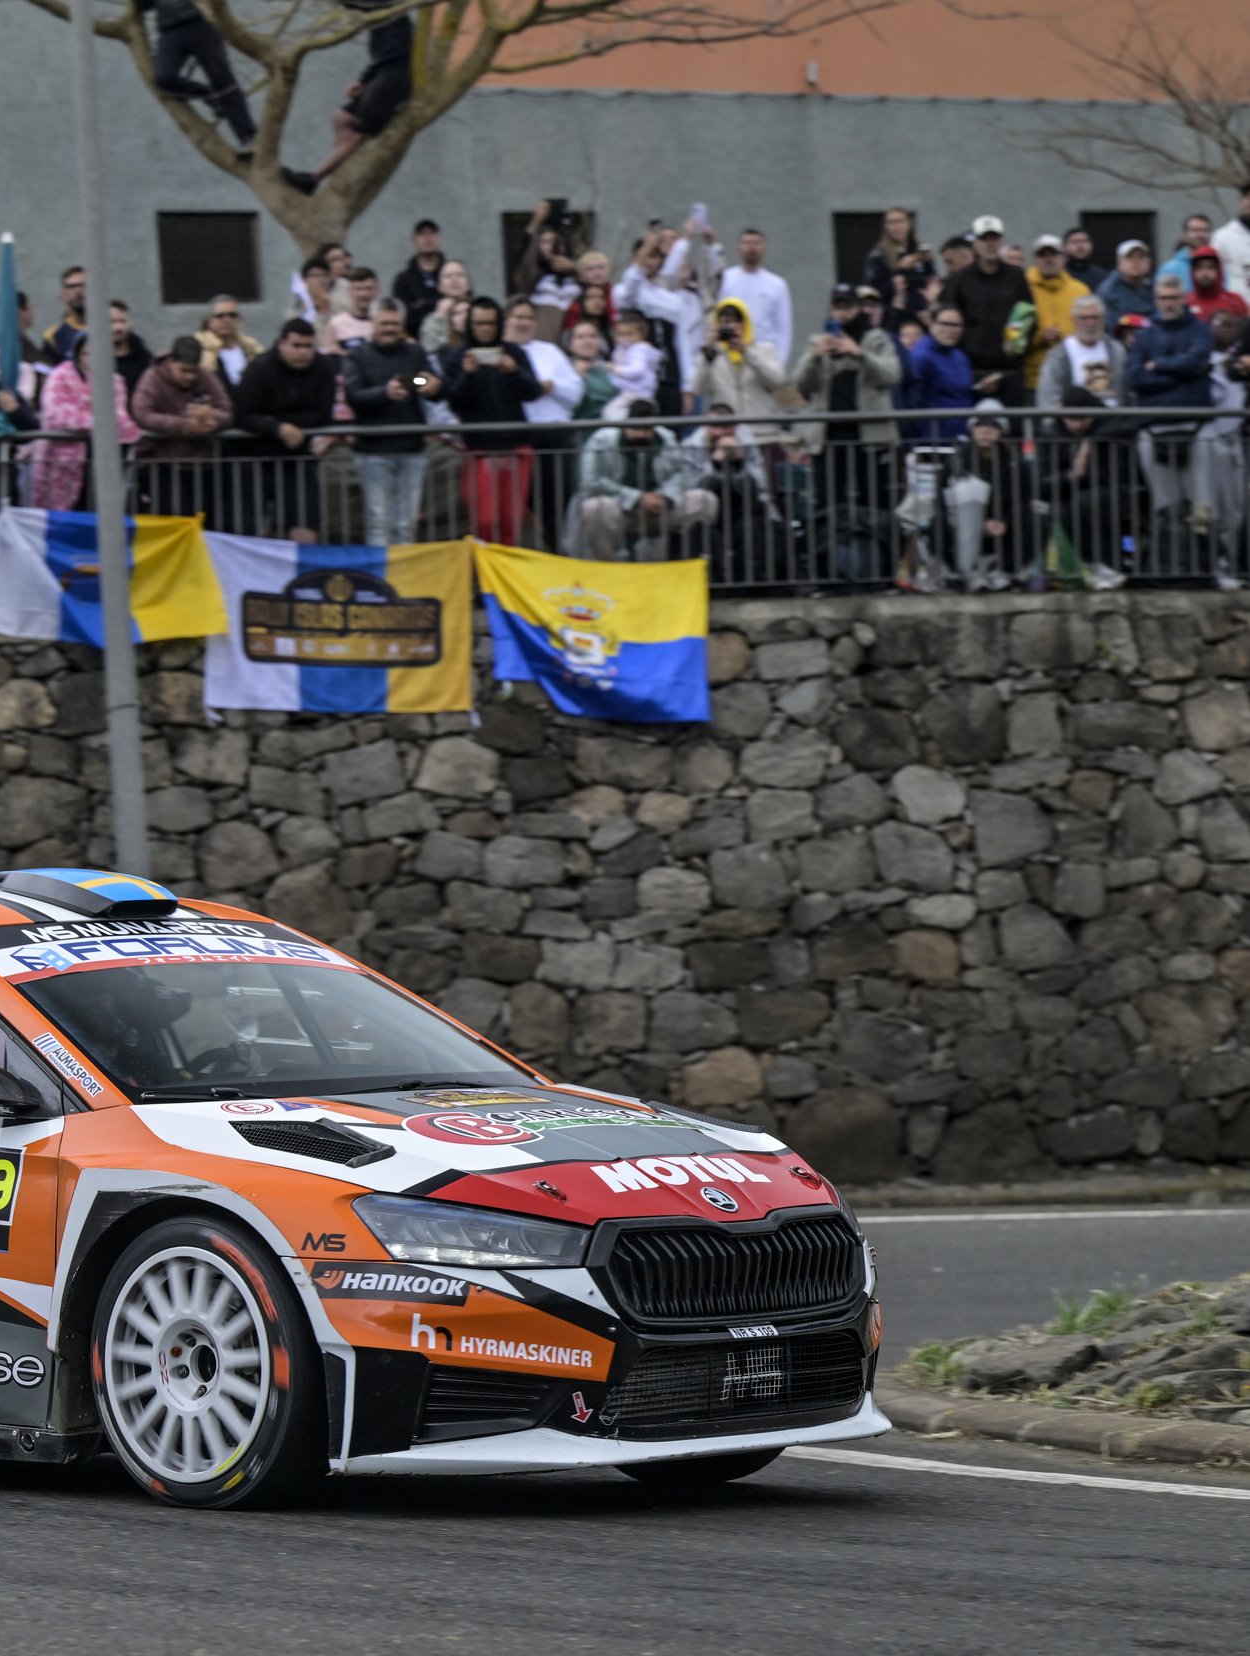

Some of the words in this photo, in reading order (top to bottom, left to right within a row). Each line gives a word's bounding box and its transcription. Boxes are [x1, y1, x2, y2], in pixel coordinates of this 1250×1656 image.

[21, 925, 79, 943] MS
[71, 920, 266, 938] MUNARETTO
[52, 1047, 103, 1096] ALMASPORT
[589, 1155, 773, 1194] MOTUL
[301, 1232, 347, 1253] MS
[460, 1335, 593, 1368] HYRMASKINER
